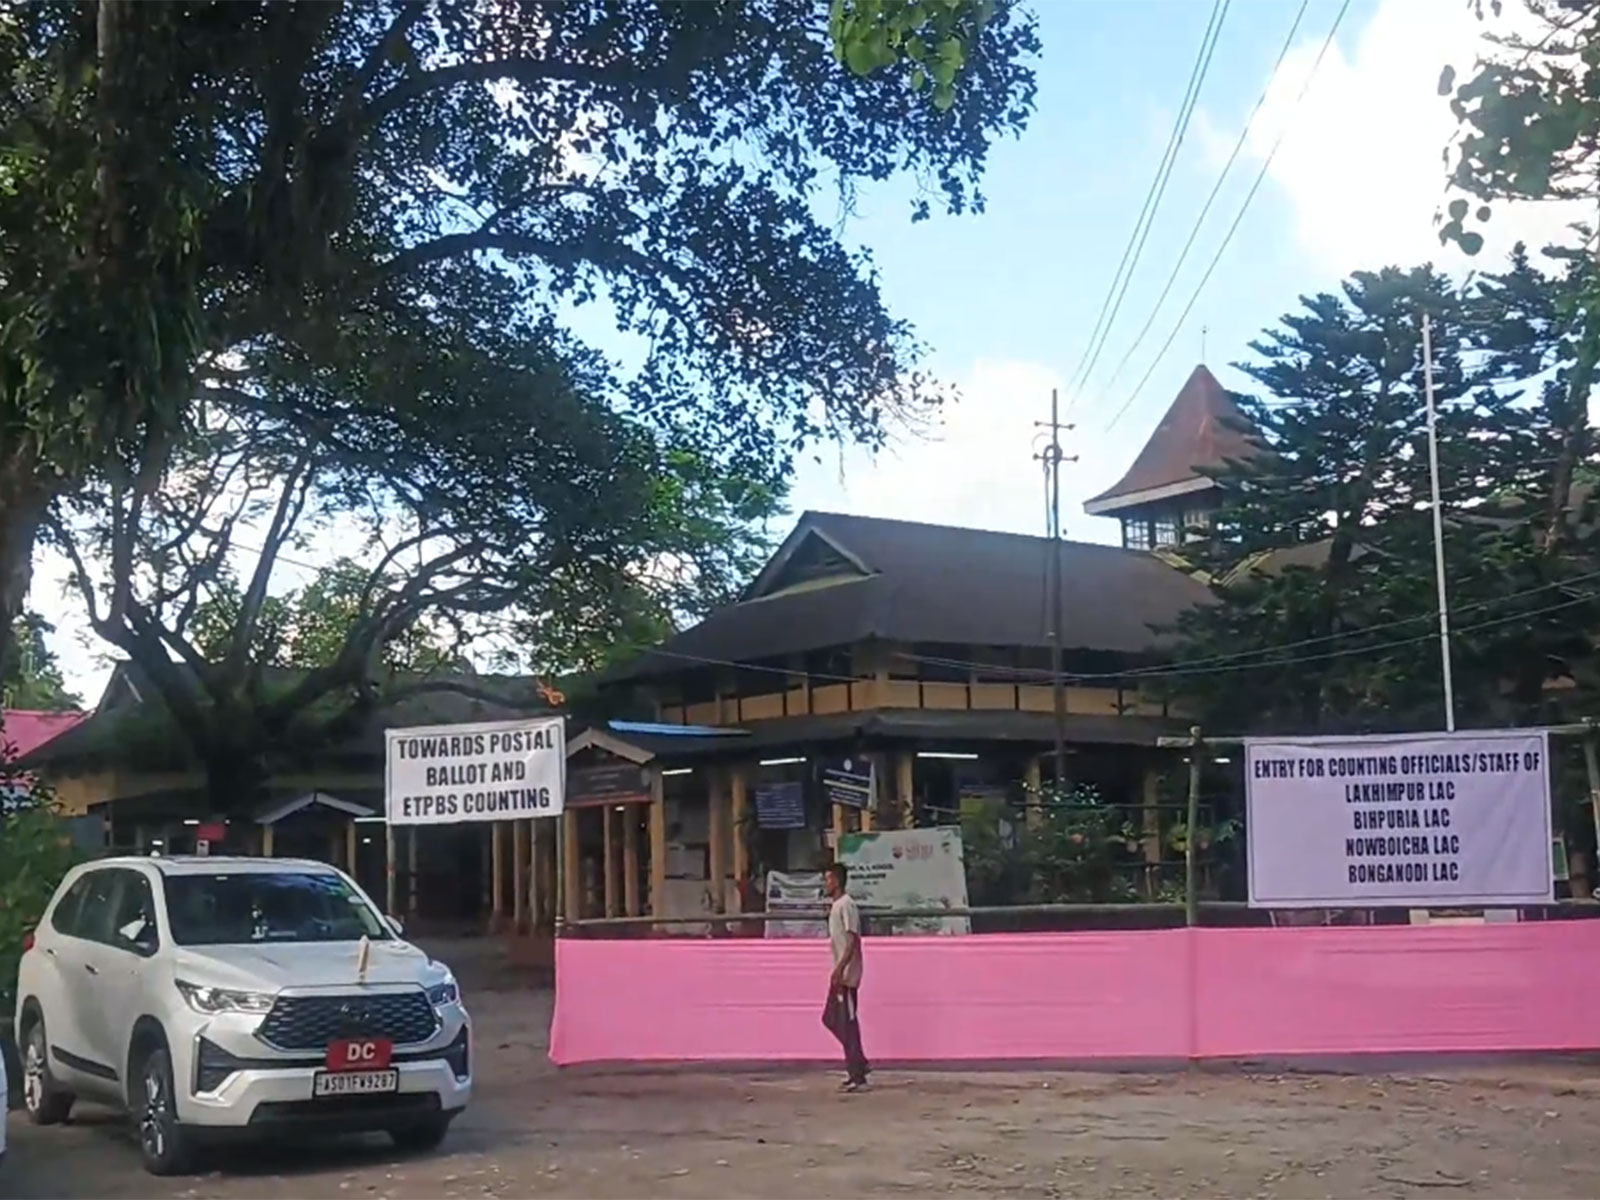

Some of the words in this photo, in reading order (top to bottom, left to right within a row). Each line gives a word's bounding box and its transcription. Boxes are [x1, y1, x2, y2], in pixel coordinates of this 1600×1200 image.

[397, 734, 485, 760] TOWARDS
[489, 729, 554, 754] POSTAL
[426, 762, 488, 787] BALLOT
[491, 760, 526, 783] AND
[1254, 759, 1296, 778] ENTRY
[1299, 758, 1325, 778] FOR
[1328, 755, 1398, 777] COUNTING
[1401, 752, 1520, 775] OFFICIALS/STAFF
[1523, 751, 1540, 772] OF
[403, 793, 458, 817] ETPBS
[463, 787, 550, 814] COUNTING
[1345, 782, 1425, 803] LAKHIMPUR
[1428, 780, 1455, 801] LAC
[1353, 809, 1420, 830] BIHPURIA
[1423, 807, 1451, 828] LAC
[1345, 836, 1429, 857] NOWBOICHA
[1433, 834, 1460, 855] LAC
[1432, 861, 1459, 881] LAC
[347, 1042, 376, 1061] DC
